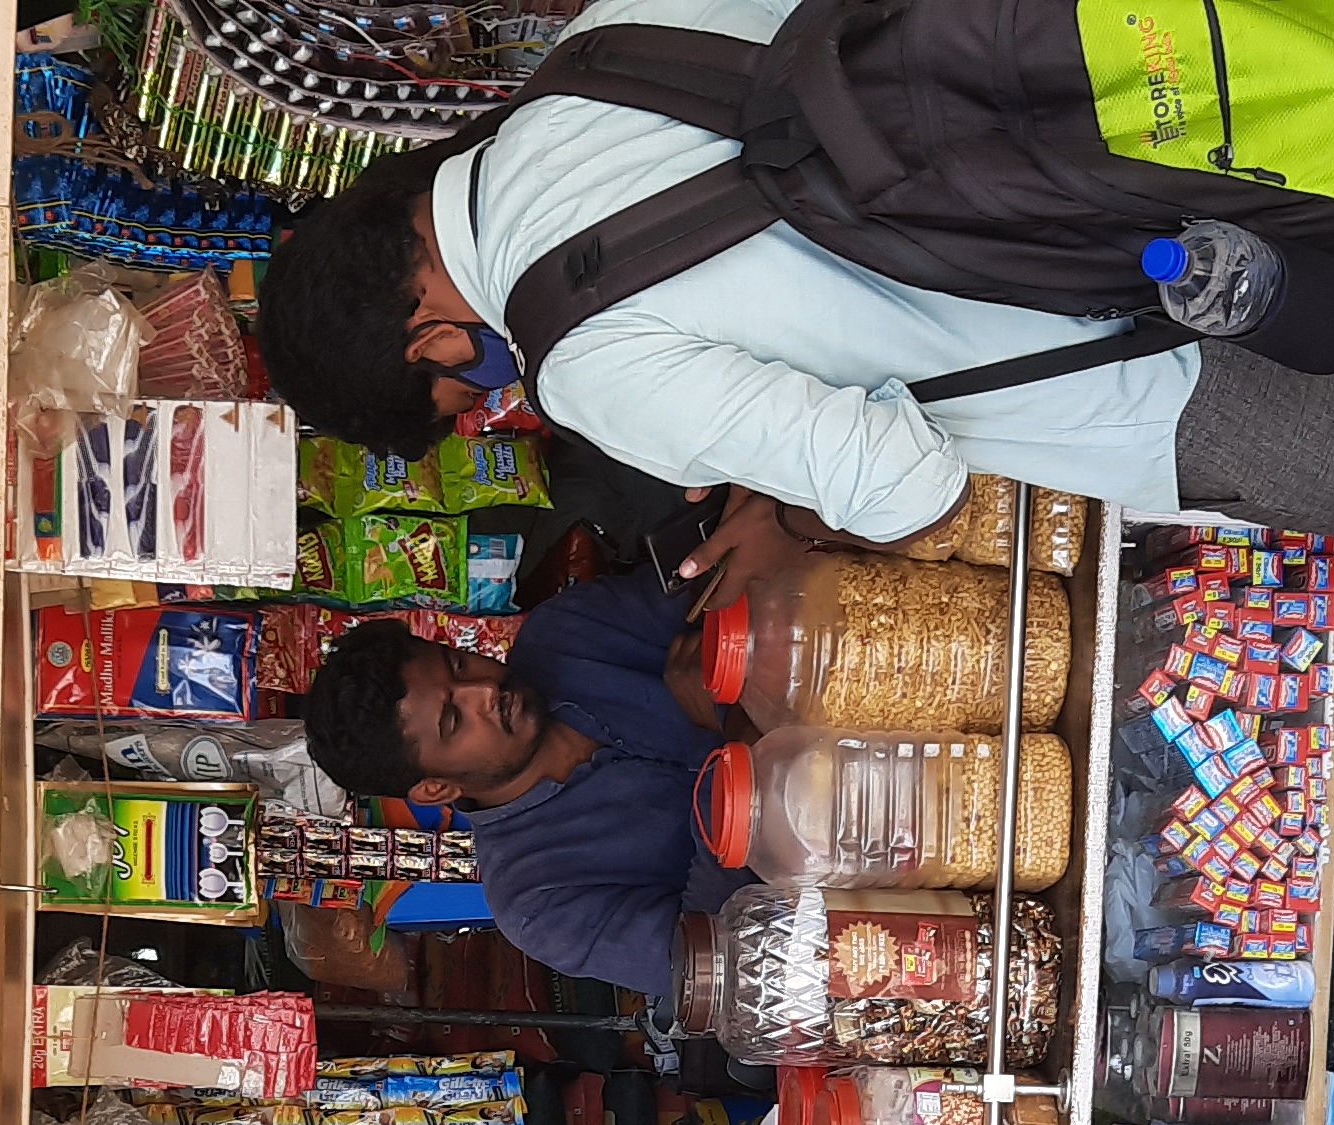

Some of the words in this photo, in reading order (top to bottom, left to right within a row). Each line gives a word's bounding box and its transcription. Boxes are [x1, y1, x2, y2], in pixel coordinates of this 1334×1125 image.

[494, 442, 508, 480] Masala
[505, 445, 516, 473] Balls
[100, 610, 115, 656] Mallika
[100, 660, 113, 705] Madhu
